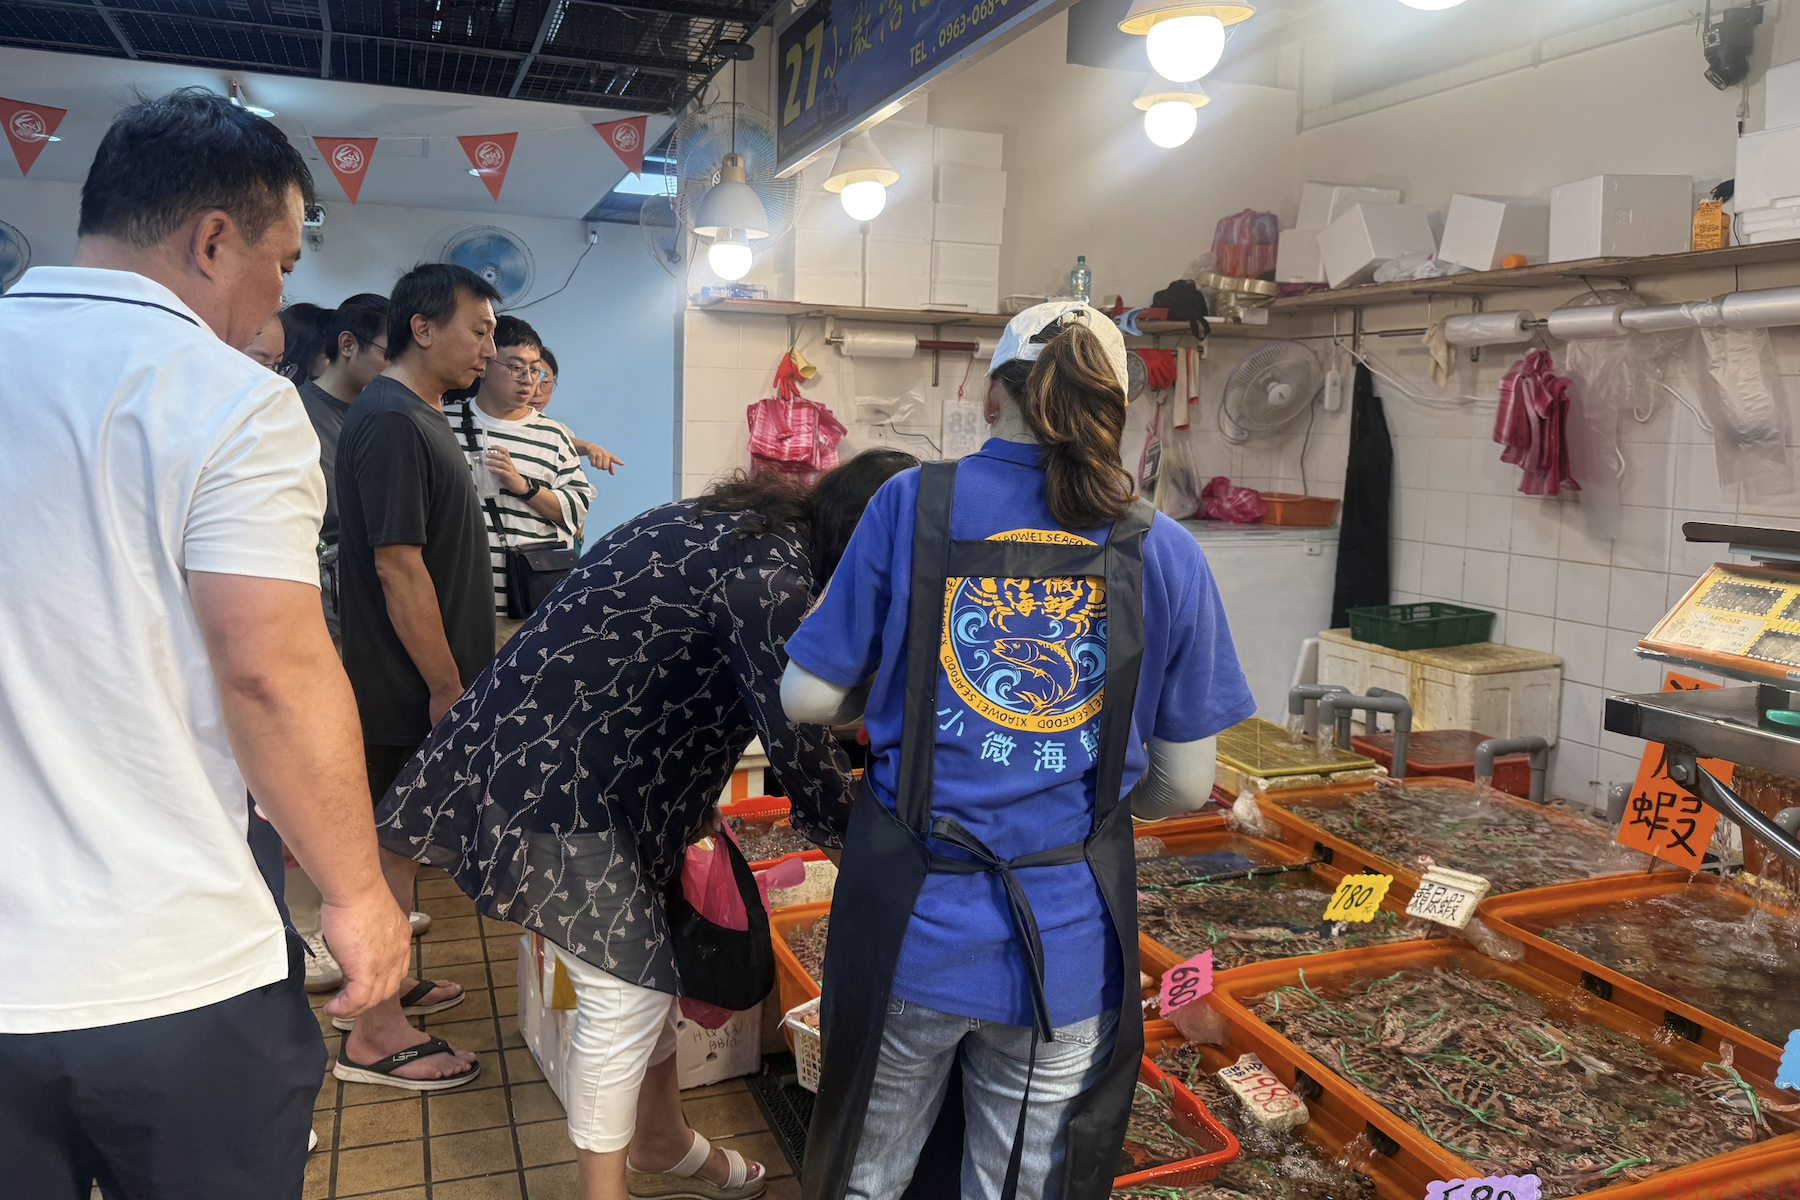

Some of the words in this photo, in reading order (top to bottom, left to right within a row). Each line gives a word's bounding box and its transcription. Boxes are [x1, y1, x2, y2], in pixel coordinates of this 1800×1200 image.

[785, 20, 825, 127] 27
[944, 655, 977, 702] SEAFOOD
[976, 699, 1028, 727] XIAOWEI
[1037, 708, 1089, 729] SEAFOOD
[1333, 884, 1374, 910] 780
[1168, 967, 1200, 1007] 680
